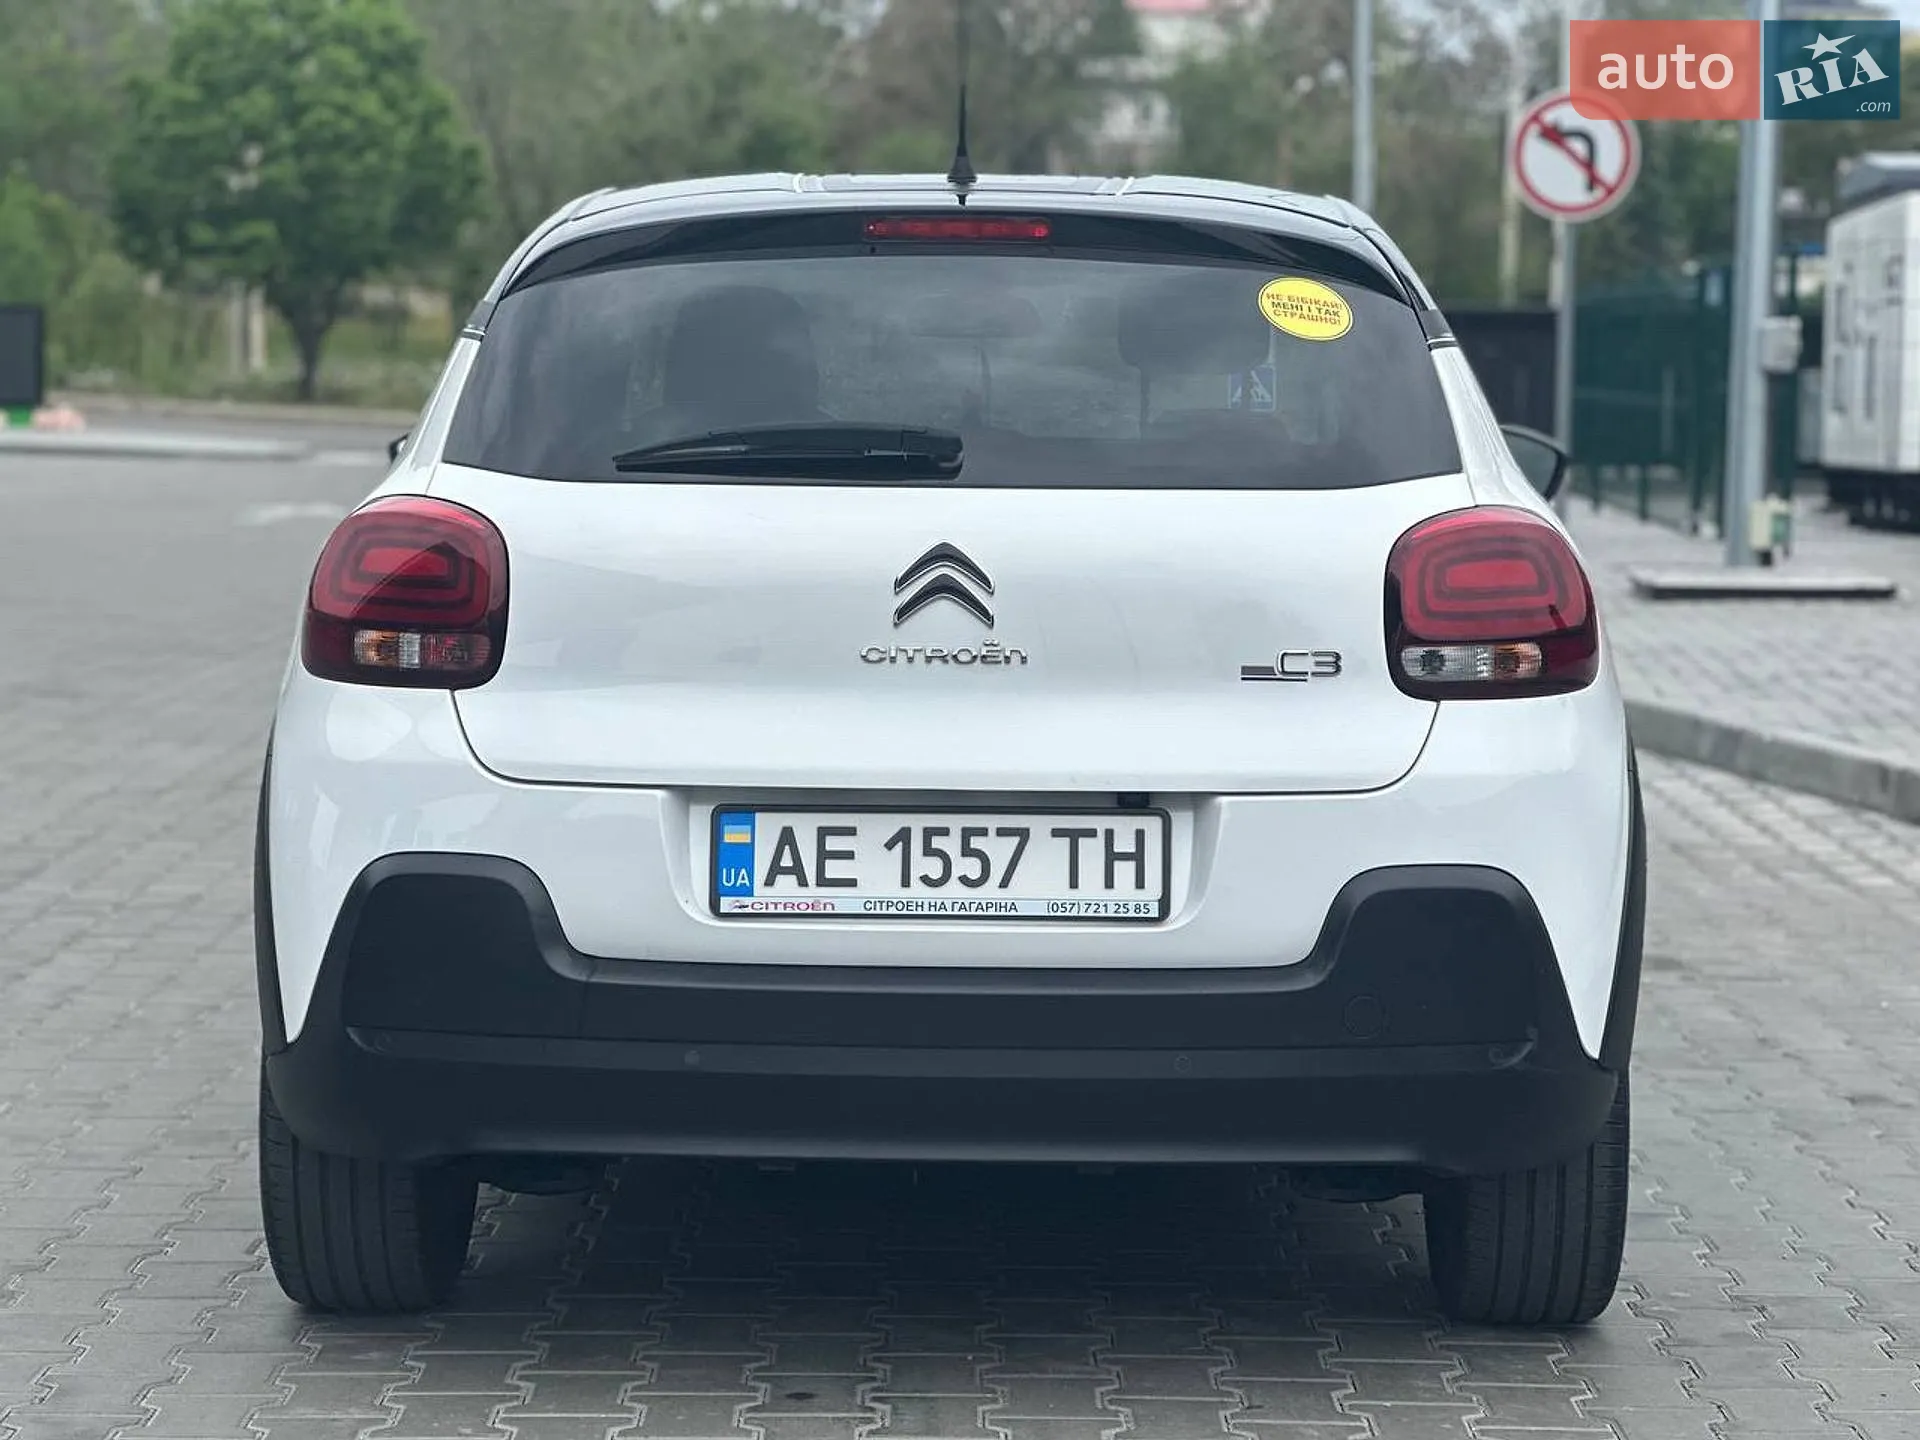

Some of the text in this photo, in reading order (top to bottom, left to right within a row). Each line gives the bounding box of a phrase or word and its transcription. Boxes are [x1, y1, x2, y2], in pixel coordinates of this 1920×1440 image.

[1266, 293, 1282, 301] НЕ
[1271, 301, 1303, 312] МЕНІ
[1316, 306, 1341, 318] ТАК
[1273, 309, 1342, 326] СТРАШНО!
[1277, 649, 1342, 677] C3
[764, 826, 1146, 890] AE 1557 TH
[722, 867, 750, 888] UA
[863, 900, 1019, 913] СІТРОЕН НА ГАГАРІНА
[1046, 902, 1151, 915] (057) 721 25 85
